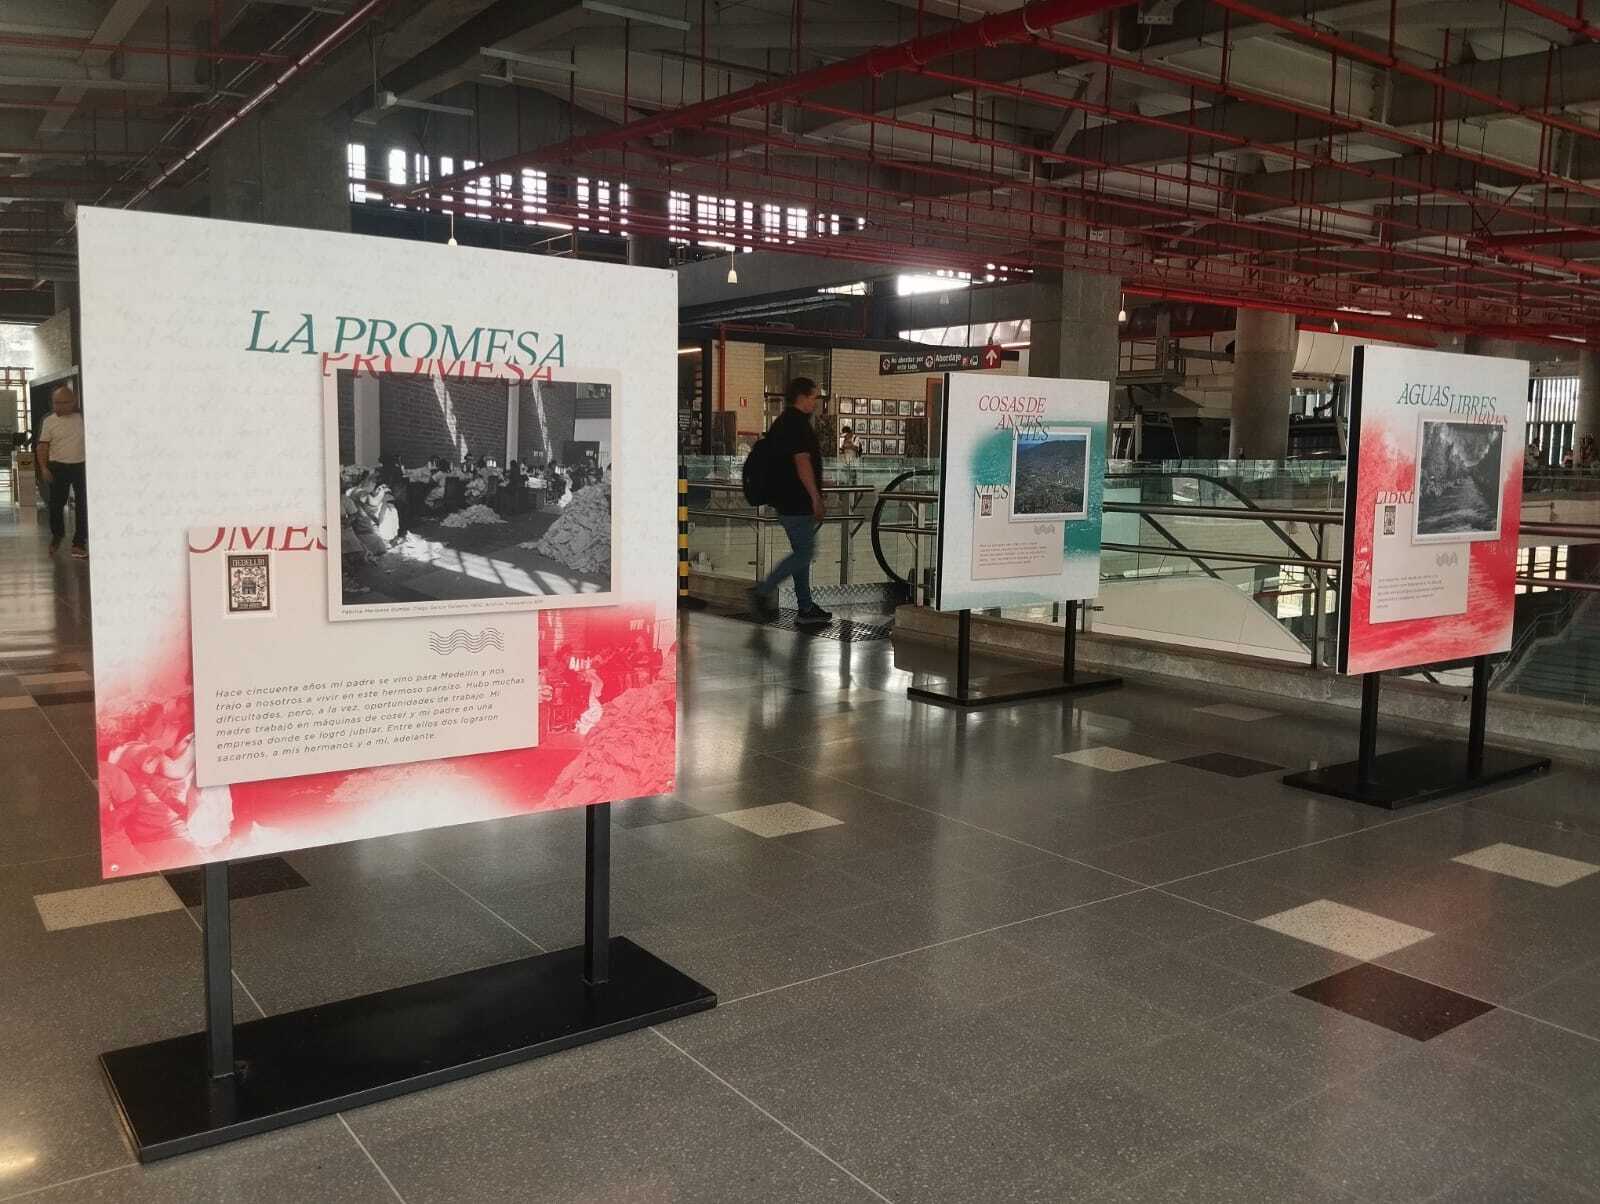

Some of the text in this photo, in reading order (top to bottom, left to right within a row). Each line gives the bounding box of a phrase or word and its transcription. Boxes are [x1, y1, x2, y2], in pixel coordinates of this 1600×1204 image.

[245, 309, 565, 368] LA PROMESA
[979, 395, 1047, 413] COSAS DE
[1396, 383, 1497, 417] AGUAS LIBRES
[995, 414, 1043, 430] ANTES
[216, 688, 242, 698] Hace
[246, 684, 298, 696] cincuenta
[302, 682, 326, 692] años
[330, 680, 343, 689] mi
[346, 678, 375, 689] padre
[393, 676, 413, 684] vino
[416, 674, 437, 684] para
[490, 668, 505, 676] nos
[216, 702, 242, 713] trajo
[256, 697, 303, 708] nosotros
[317, 693, 338, 702] vivir
[342, 692, 354, 700] en
[357, 690, 378, 698] este
[382, 686, 423, 696] hermoso
[466, 680, 489, 690] Hubo
[492, 677, 525, 686] muchas
[328, 704, 337, 713] la
[364, 696, 434, 711] oportunidades
[489, 690, 500, 698] Mi
[216, 726, 251, 737] madre
[365, 713, 377, 722] de
[418, 709, 430, 717] mi
[433, 706, 460, 716] padre
[477, 703, 493, 712] una
[217, 740, 263, 752] empresa
[267, 734, 300, 745] donde
[387, 723, 412, 733] Entre
[416, 720, 438, 729] ellos
[441, 718, 457, 726] dos
[460, 714, 498, 727] lograron
[272, 749, 279, 757] a
[282, 747, 300, 756] mis
[304, 740, 353, 754] hermanos
